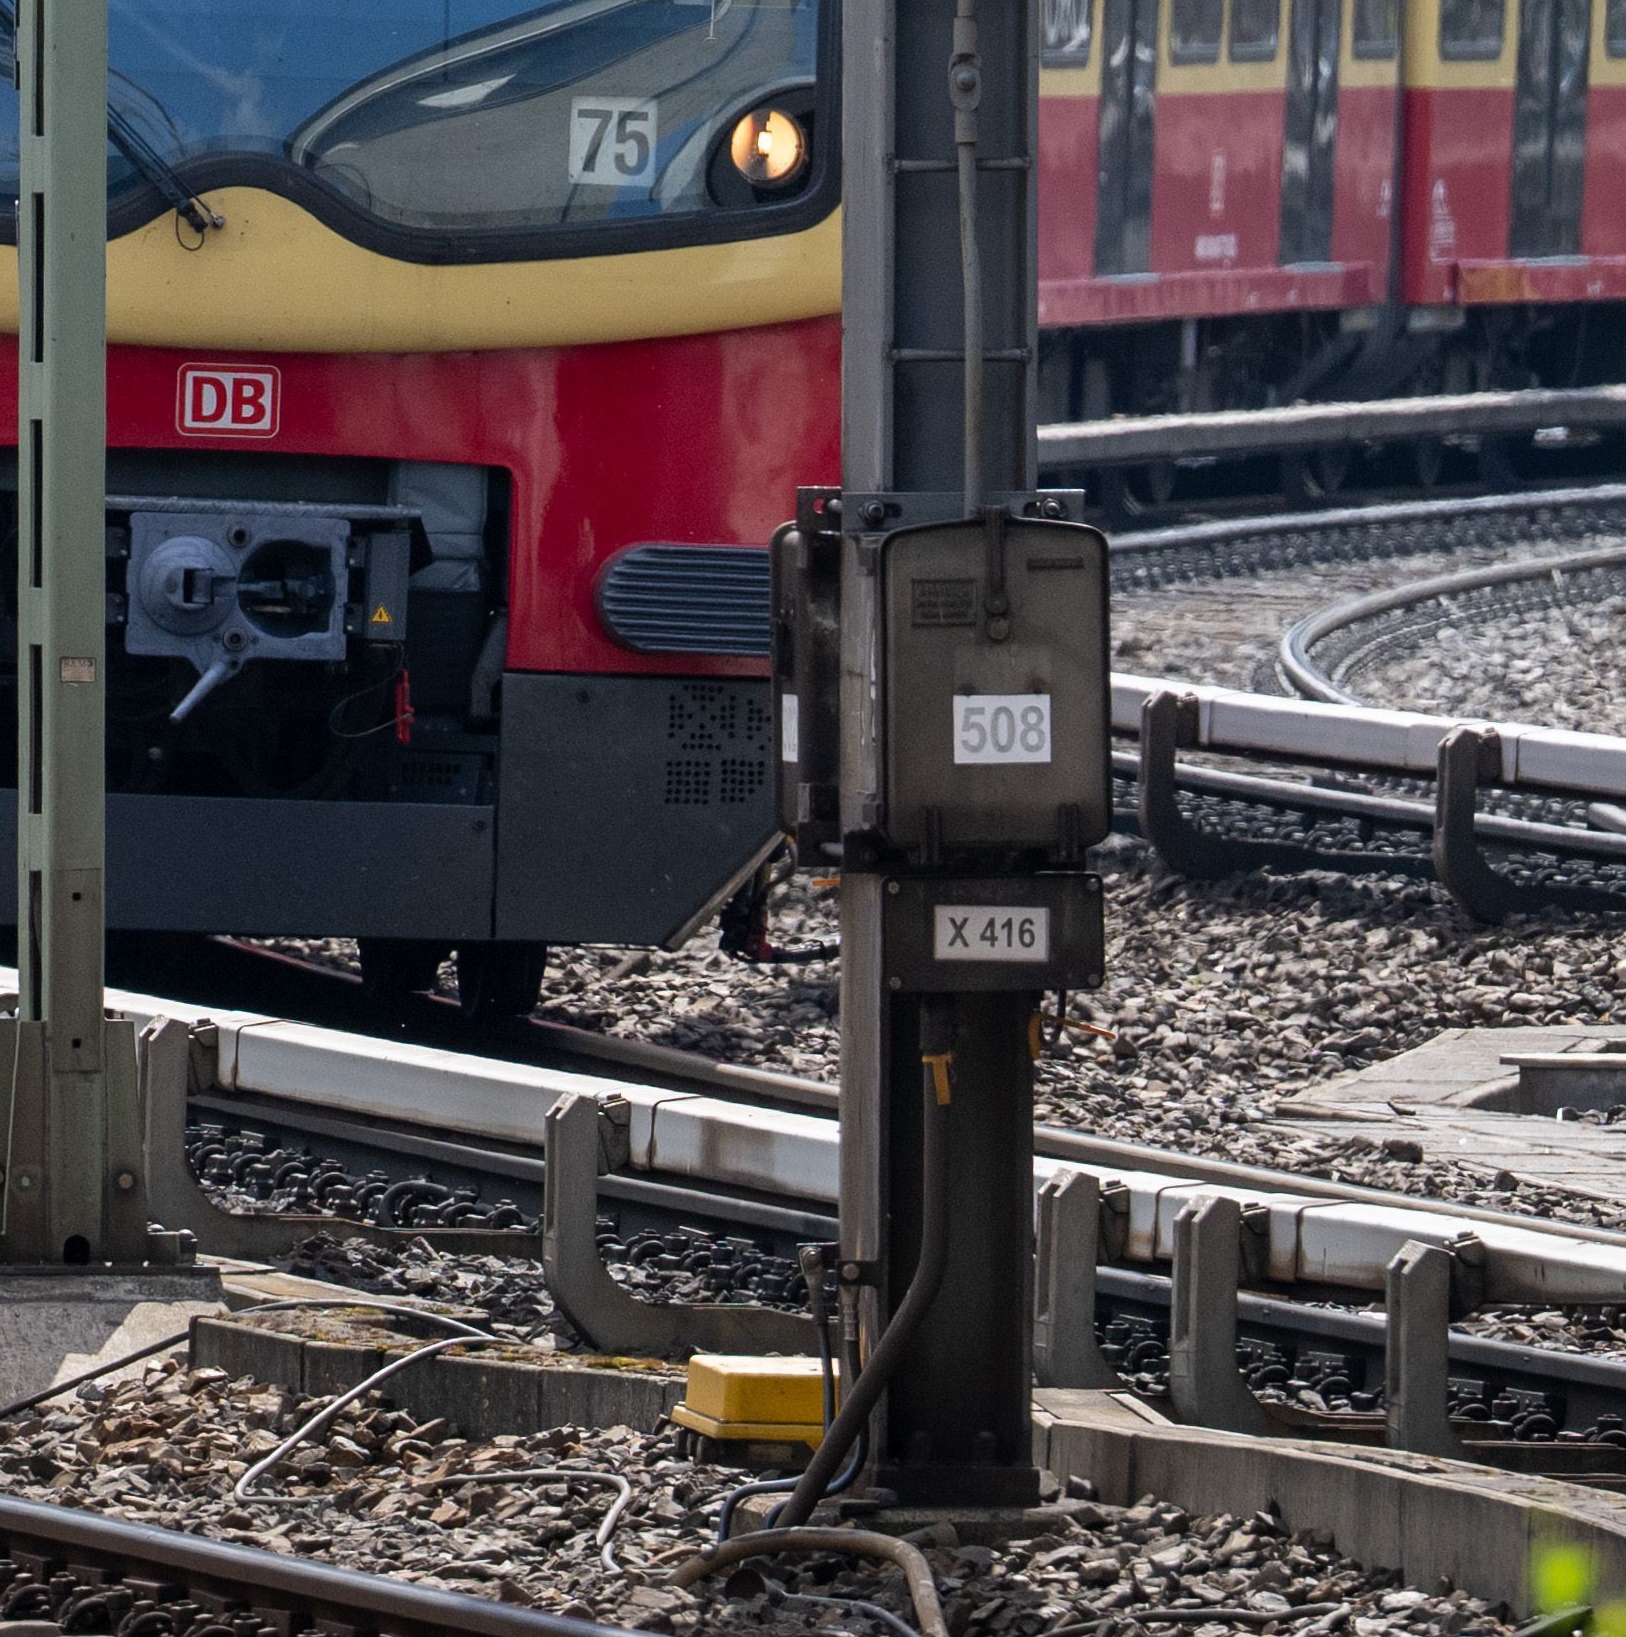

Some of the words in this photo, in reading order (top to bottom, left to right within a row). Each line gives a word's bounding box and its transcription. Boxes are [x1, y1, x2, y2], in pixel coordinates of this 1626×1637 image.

[577, 108, 650, 176] 75
[191, 375, 266, 425] DB
[961, 706, 1046, 753] 508
[948, 917, 969, 947] X
[979, 917, 1035, 948] 416
